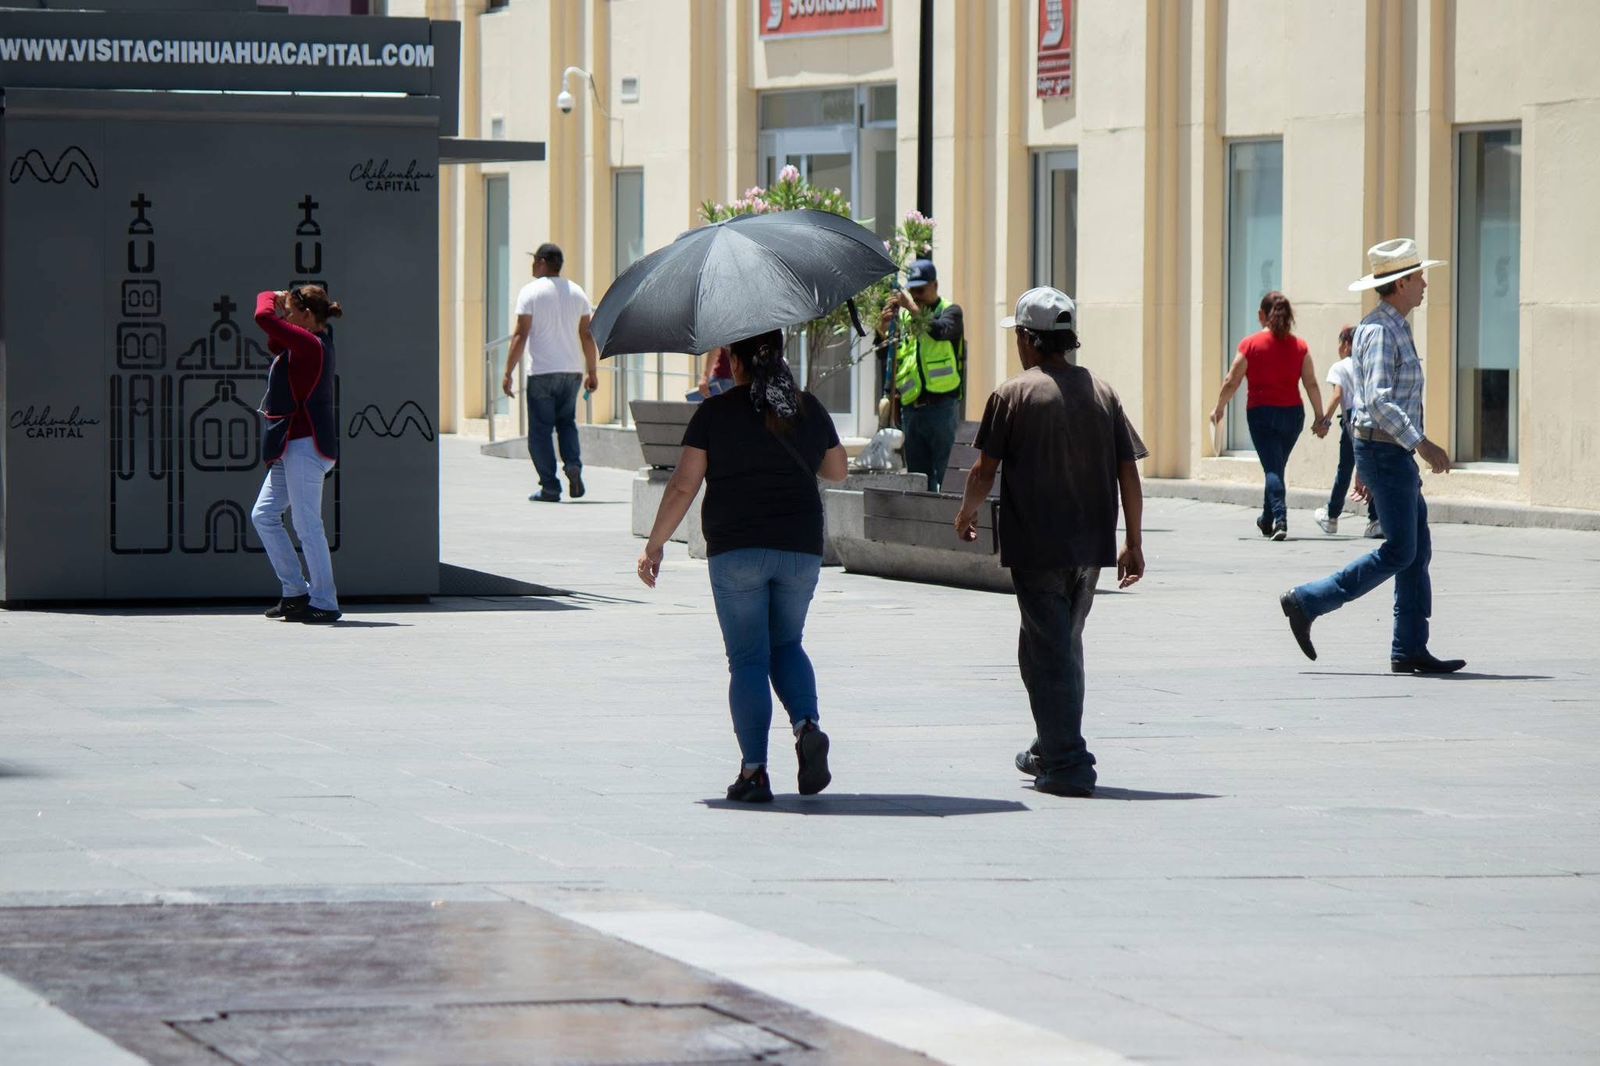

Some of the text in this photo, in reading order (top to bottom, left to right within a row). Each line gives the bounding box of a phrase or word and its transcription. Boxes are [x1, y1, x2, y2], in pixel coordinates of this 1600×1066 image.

[0, 38, 435, 67] WWW.VISITACHIHUAHUACAPITAL.COM
[349, 158, 434, 182] Chihuahua
[365, 180, 420, 192] CAPITAL
[10, 405, 100, 429] Chihuahua
[26, 427, 84, 438] CAPITAL
